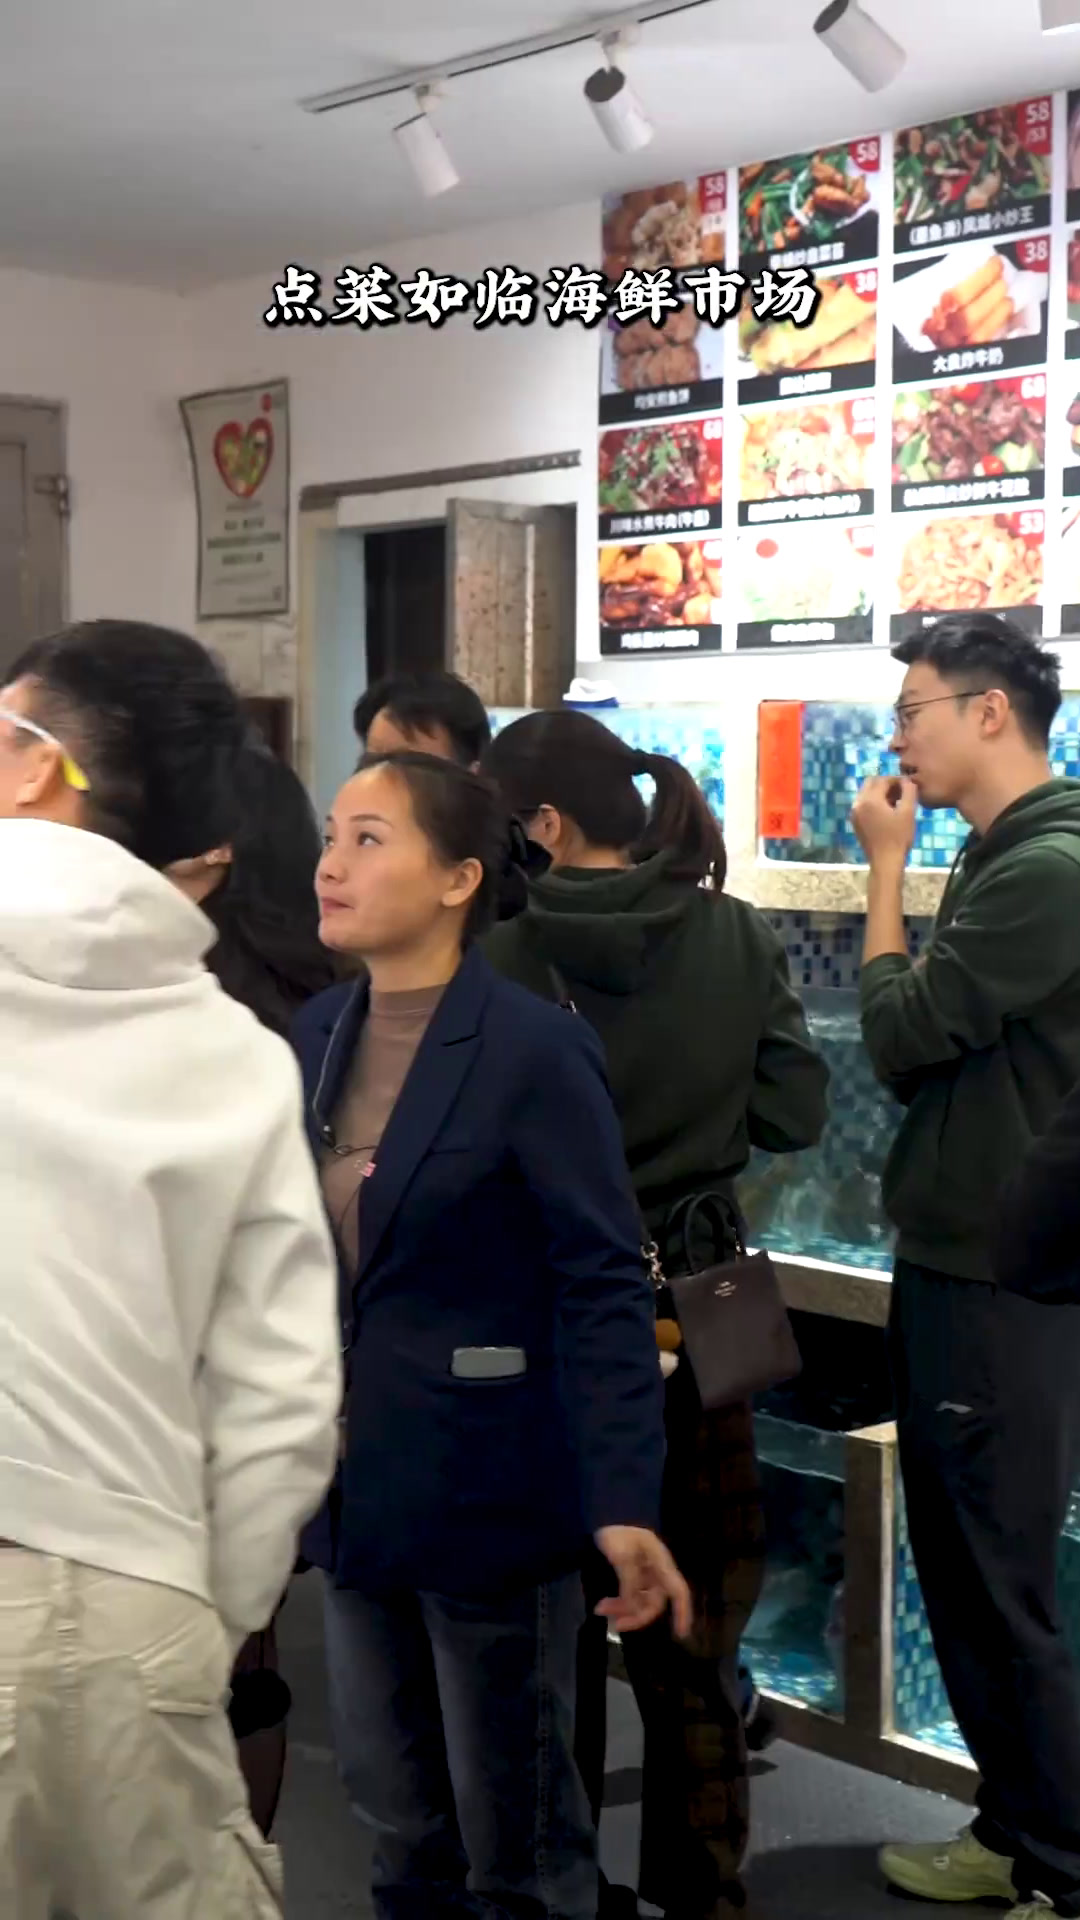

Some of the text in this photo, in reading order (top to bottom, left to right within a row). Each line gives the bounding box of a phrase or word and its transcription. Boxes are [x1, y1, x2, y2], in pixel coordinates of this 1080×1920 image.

[1026, 100, 1050, 124] 58
[857, 140, 878, 163] 58
[705, 175, 725, 197] 58
[1024, 239, 1048, 263] 38
[855, 270, 877, 293] 38
